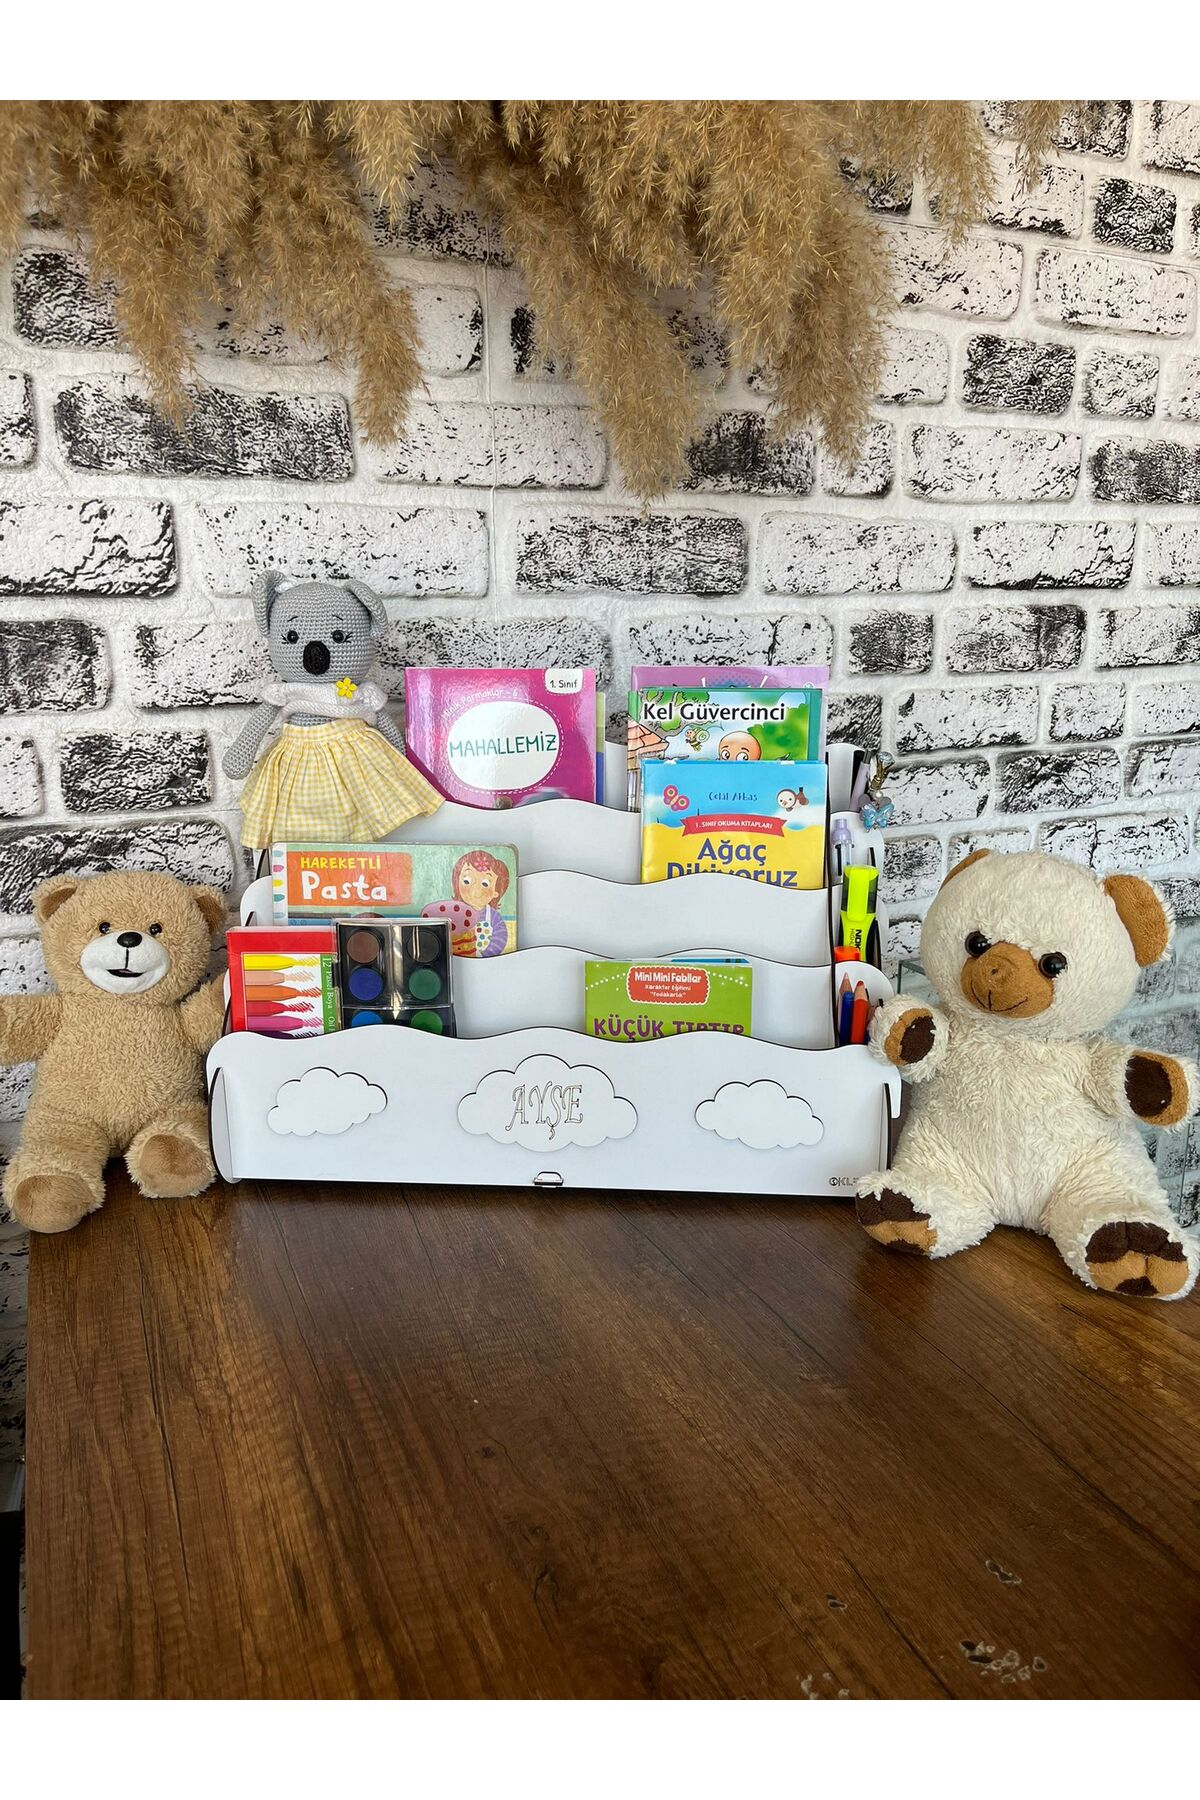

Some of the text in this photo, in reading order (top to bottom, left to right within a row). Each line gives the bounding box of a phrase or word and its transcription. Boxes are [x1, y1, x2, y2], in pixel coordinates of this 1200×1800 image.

[549, 679, 578, 688] 1. Sınıf
[512, 688, 518, 697] 6
[643, 702, 785, 721] Kel Güvercinci
[449, 731, 558, 758] MAHALLEMİZ
[702, 820, 718, 828] SINIF
[740, 820, 773, 829] KİTAPLARI
[697, 837, 767, 866] Ağaç
[300, 855, 382, 870] HAREKETLİ
[301, 870, 388, 901] Pasta
[322, 957, 332, 968] 12
[634, 971, 653, 982] Mini
[652, 972, 671, 982] Mini
[593, 1013, 665, 1041] KÜÇÜK
[504, 1080, 584, 1141] AYŞE
